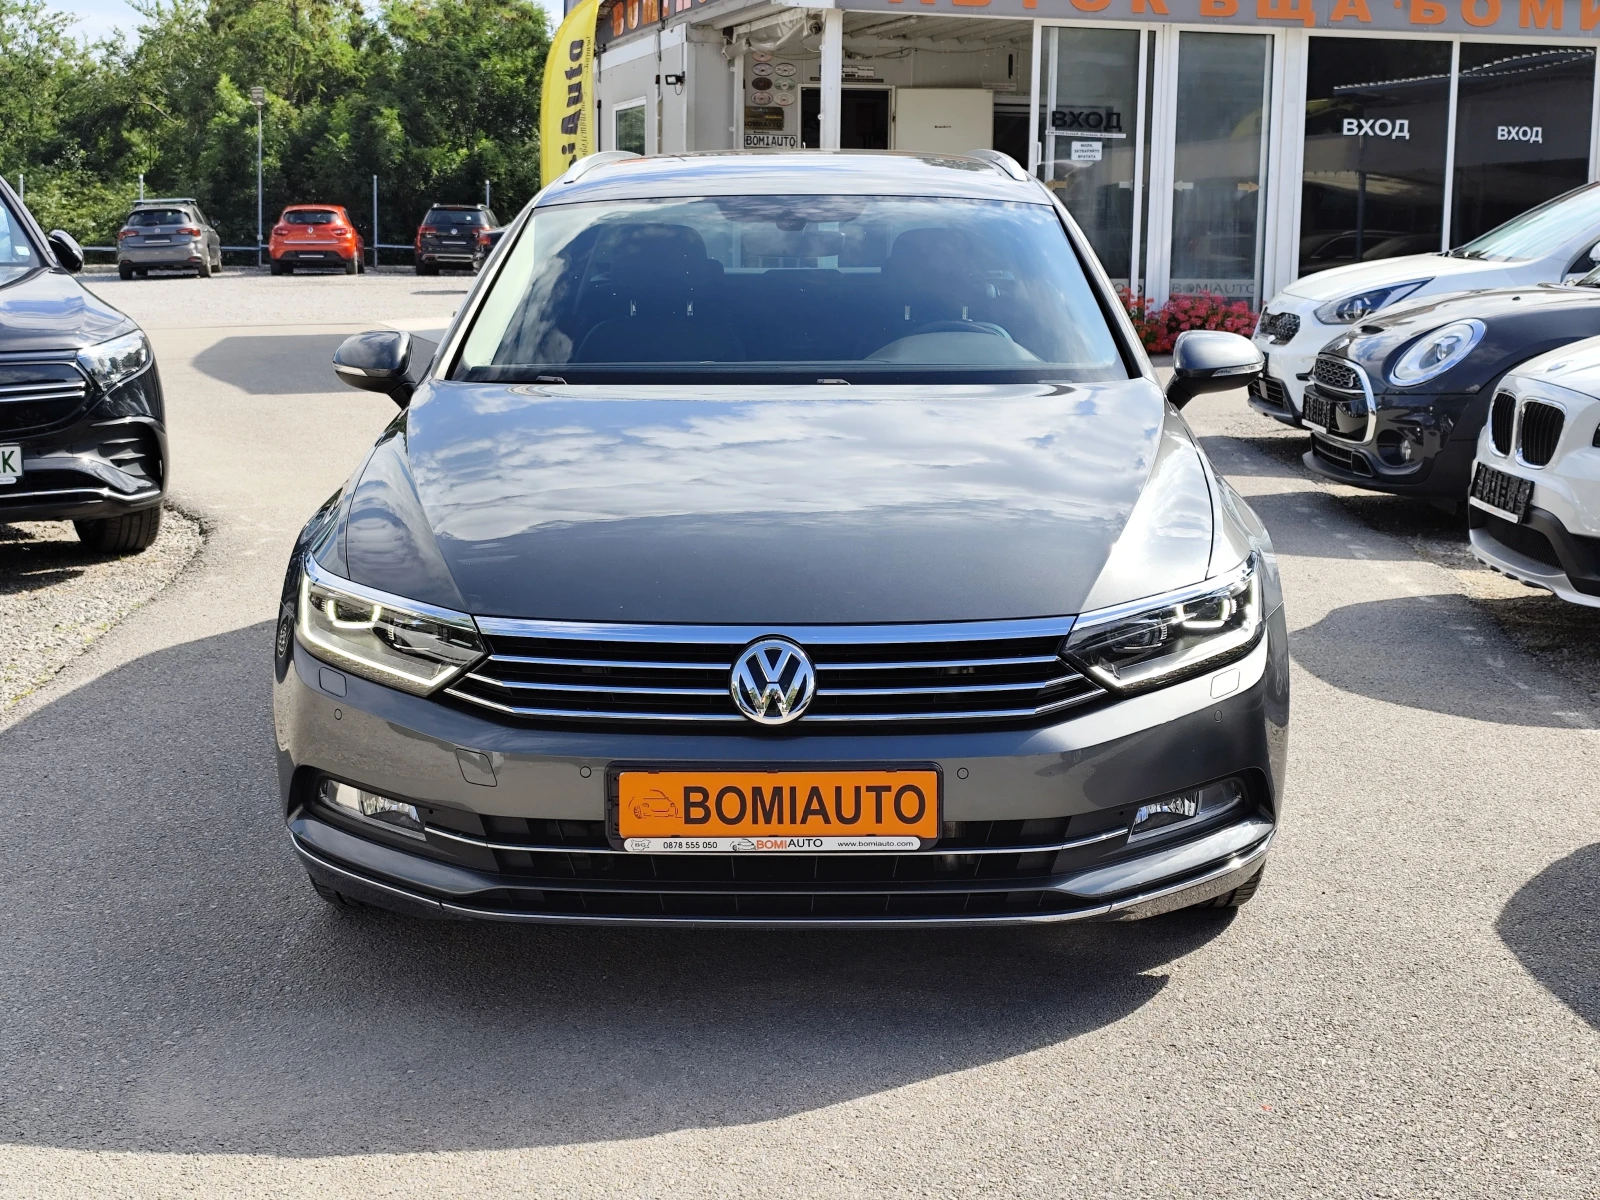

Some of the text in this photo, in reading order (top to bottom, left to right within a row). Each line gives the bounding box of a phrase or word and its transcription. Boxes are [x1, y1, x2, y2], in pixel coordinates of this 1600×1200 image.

[560, 39, 585, 135] Auto
[1052, 110, 1122, 132] ВХОД
[1342, 118, 1410, 140] ВХОД
[745, 135, 796, 147] BOMIAUTO
[1497, 126, 1543, 144] ВХОД
[683, 784, 926, 827] BOMIAUTO
[662, 841, 718, 849] 0878 555 050
[756, 838, 824, 850] BOMIAUTO
